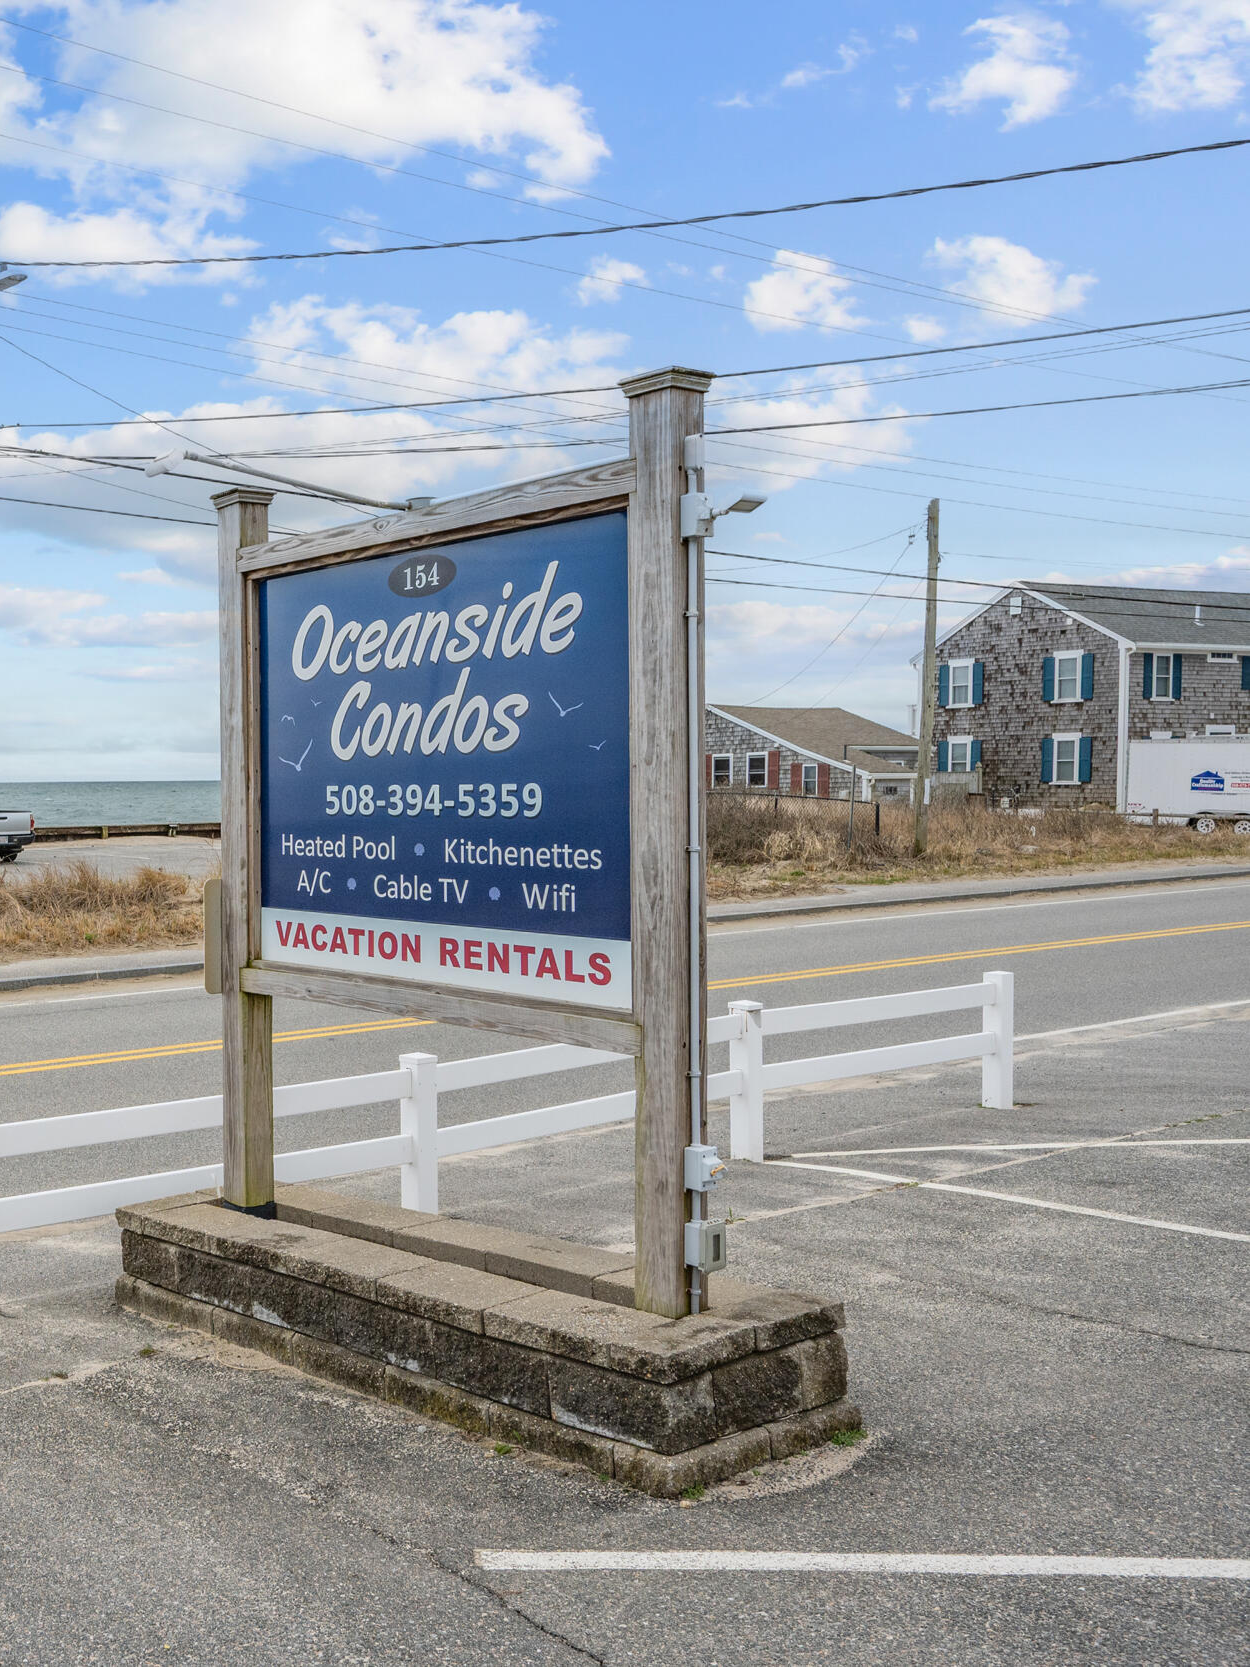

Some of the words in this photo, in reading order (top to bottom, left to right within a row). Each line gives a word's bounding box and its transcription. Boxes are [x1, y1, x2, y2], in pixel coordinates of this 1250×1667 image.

[403, 562, 440, 591] 154
[291, 560, 583, 681] Oceanside
[330, 667, 529, 761] Condos
[325, 783, 543, 818] 508-394-5359
[281, 834, 346, 859] Heated
[352, 836, 396, 861] Pool
[444, 838, 603, 870] Kitchenettes
[297, 868, 332, 897] A/C
[373, 874, 432, 901] Cable
[439, 878, 469, 904] TV
[522, 883, 576, 913] Wifi
[275, 920, 421, 963] VACATION
[439, 937, 612, 986] RENTALS
